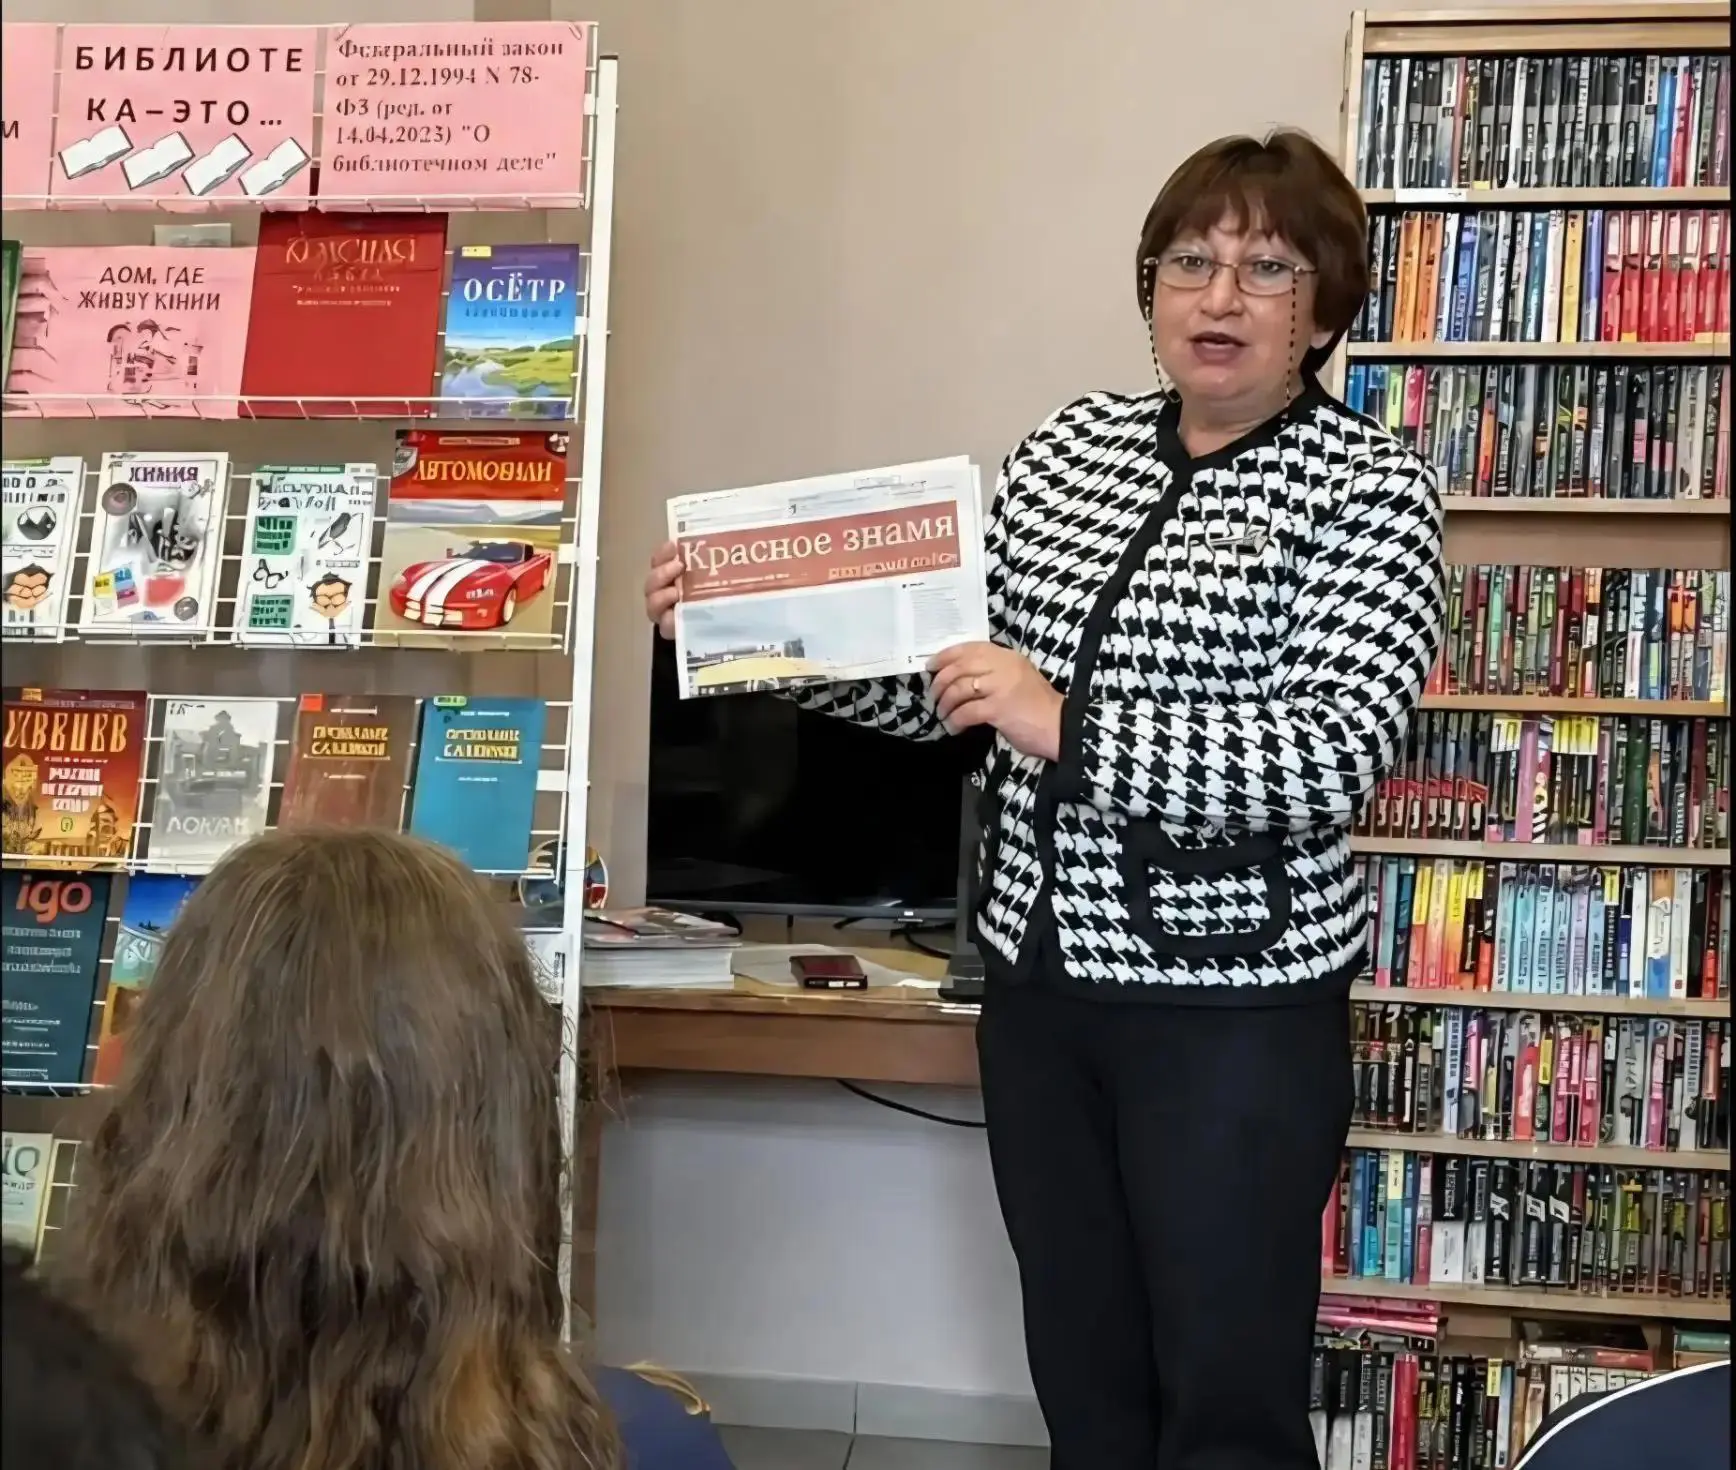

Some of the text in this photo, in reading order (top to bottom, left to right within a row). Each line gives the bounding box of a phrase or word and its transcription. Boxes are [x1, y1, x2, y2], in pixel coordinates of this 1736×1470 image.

[75, 45, 304, 73] БИБЛИОТЕ
[366, 67, 477, 87] 29.12.1994
[509, 65, 541, 84] 78-
[335, 98, 370, 116] ФЗ
[335, 125, 453, 145] 14.04.2023)
[332, 152, 557, 172] библиотечном деле"
[165, 265, 206, 288] ГДЕ
[681, 531, 832, 577] Красное
[842, 514, 955, 552] знамя
